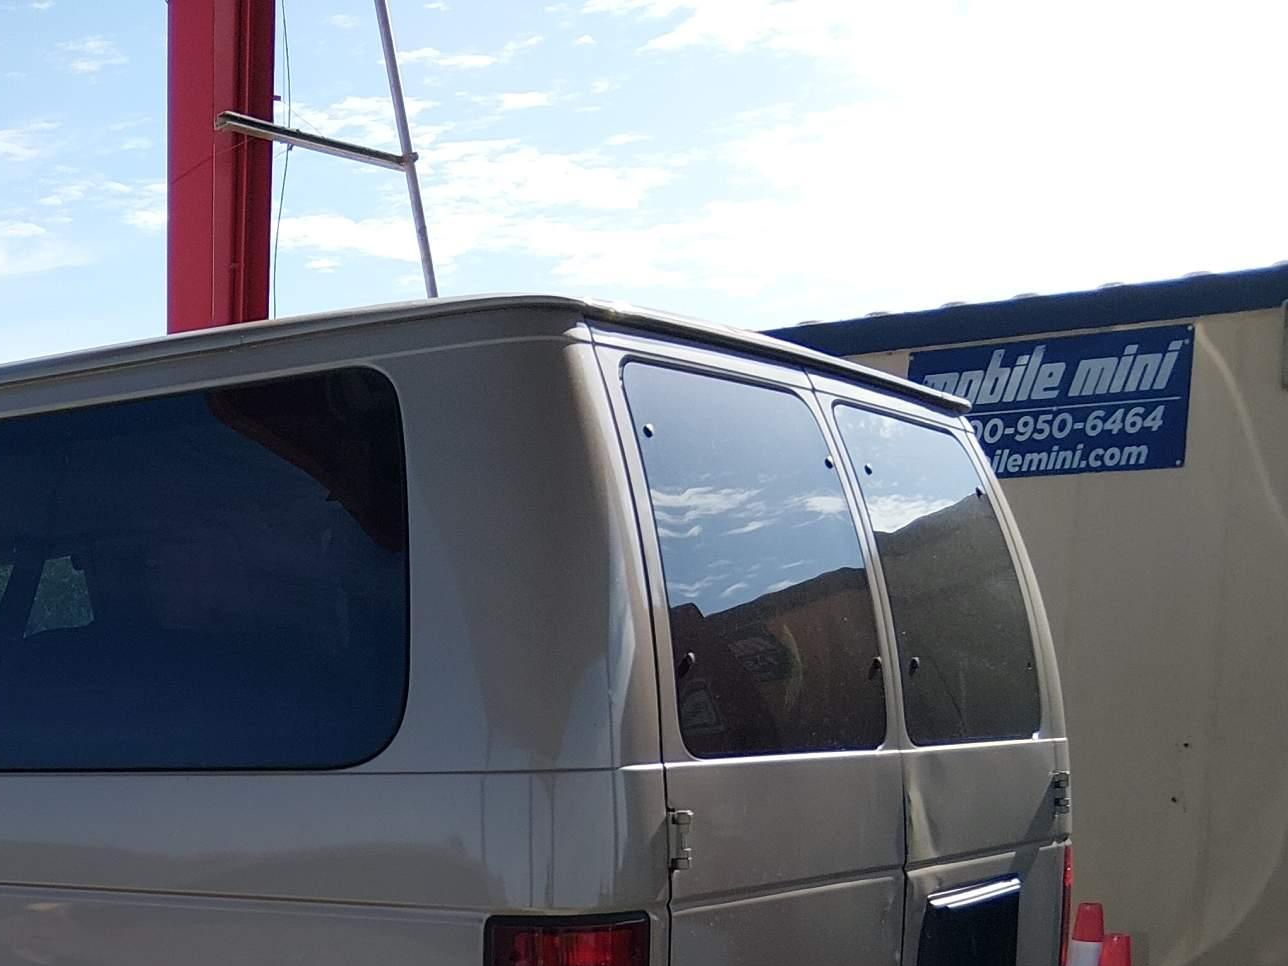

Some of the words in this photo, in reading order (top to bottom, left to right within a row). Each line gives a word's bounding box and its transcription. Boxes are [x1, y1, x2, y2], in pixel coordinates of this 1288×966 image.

[922, 345, 1067, 405] mobile
[1067, 340, 1183, 397] mini
[970, 405, 1166, 444] 00-950-6464
[991, 443, 1149, 473] ilemini.com
